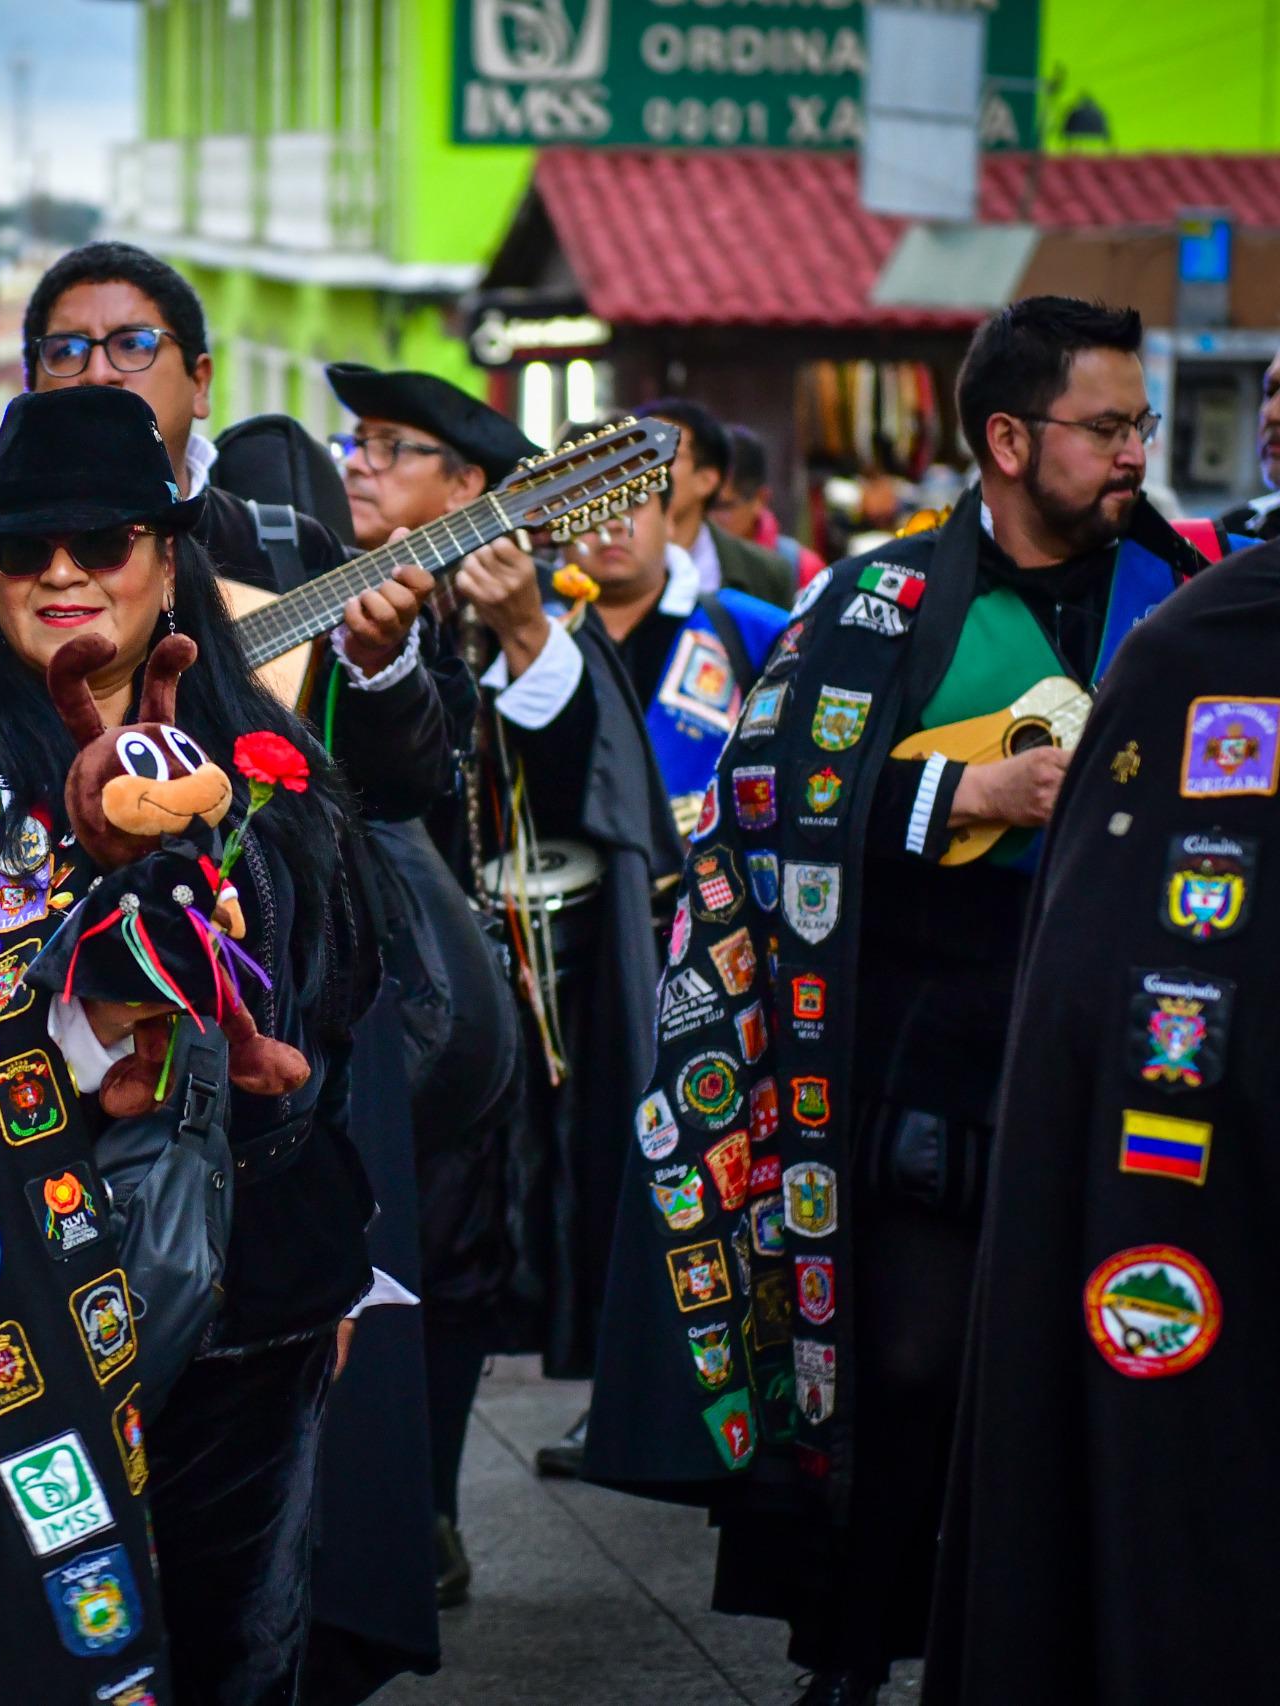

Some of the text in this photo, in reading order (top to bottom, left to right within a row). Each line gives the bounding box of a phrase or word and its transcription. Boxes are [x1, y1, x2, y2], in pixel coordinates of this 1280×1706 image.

[641, 23, 866, 74] ORDINA
[464, 80, 611, 138] IMSS
[643, 95, 1019, 144] 0001 XAA
[21, 832, 38, 843] 24
[799, 816, 838, 827] VERACRUZ
[60, 1212, 87, 1231] XLVI
[41, 1503, 100, 1546] IMSS
